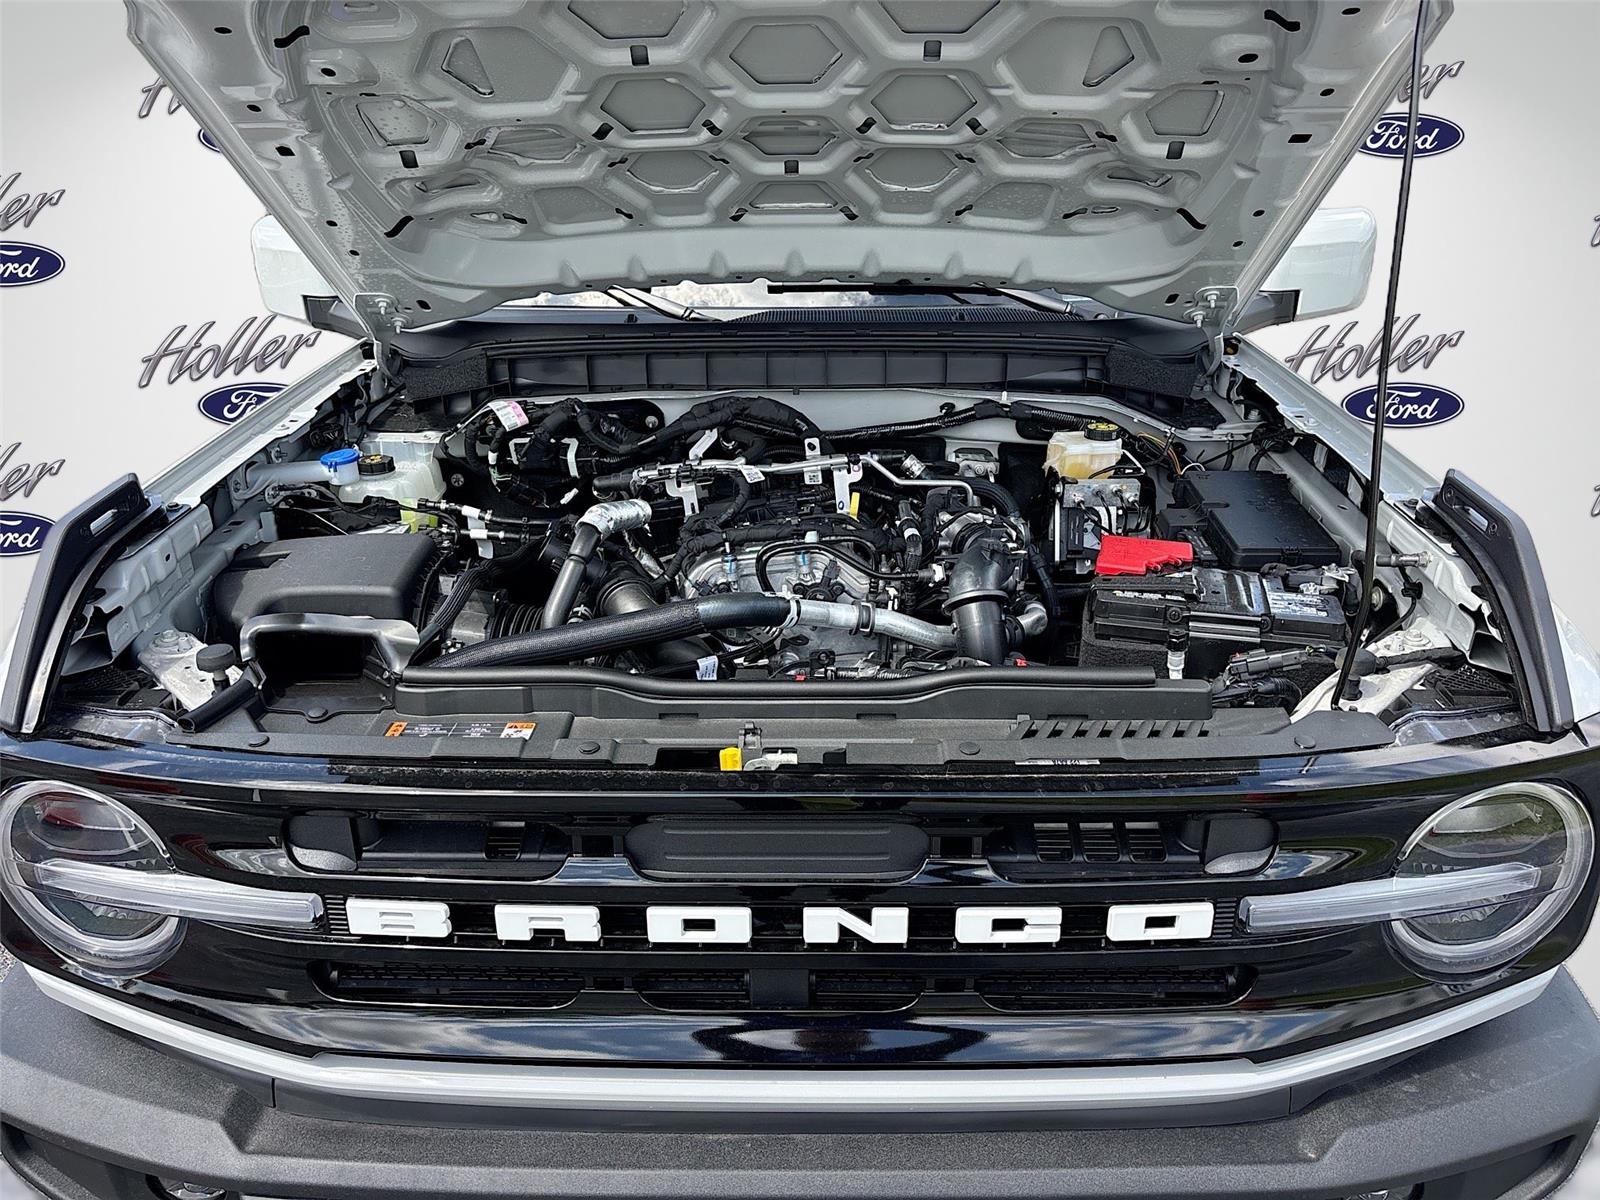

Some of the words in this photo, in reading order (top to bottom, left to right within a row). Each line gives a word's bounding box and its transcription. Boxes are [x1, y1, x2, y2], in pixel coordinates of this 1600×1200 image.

[138, 314, 322, 389] Holler
[1285, 313, 1465, 384] Holler
[346, 897, 1215, 944] BRONCO
